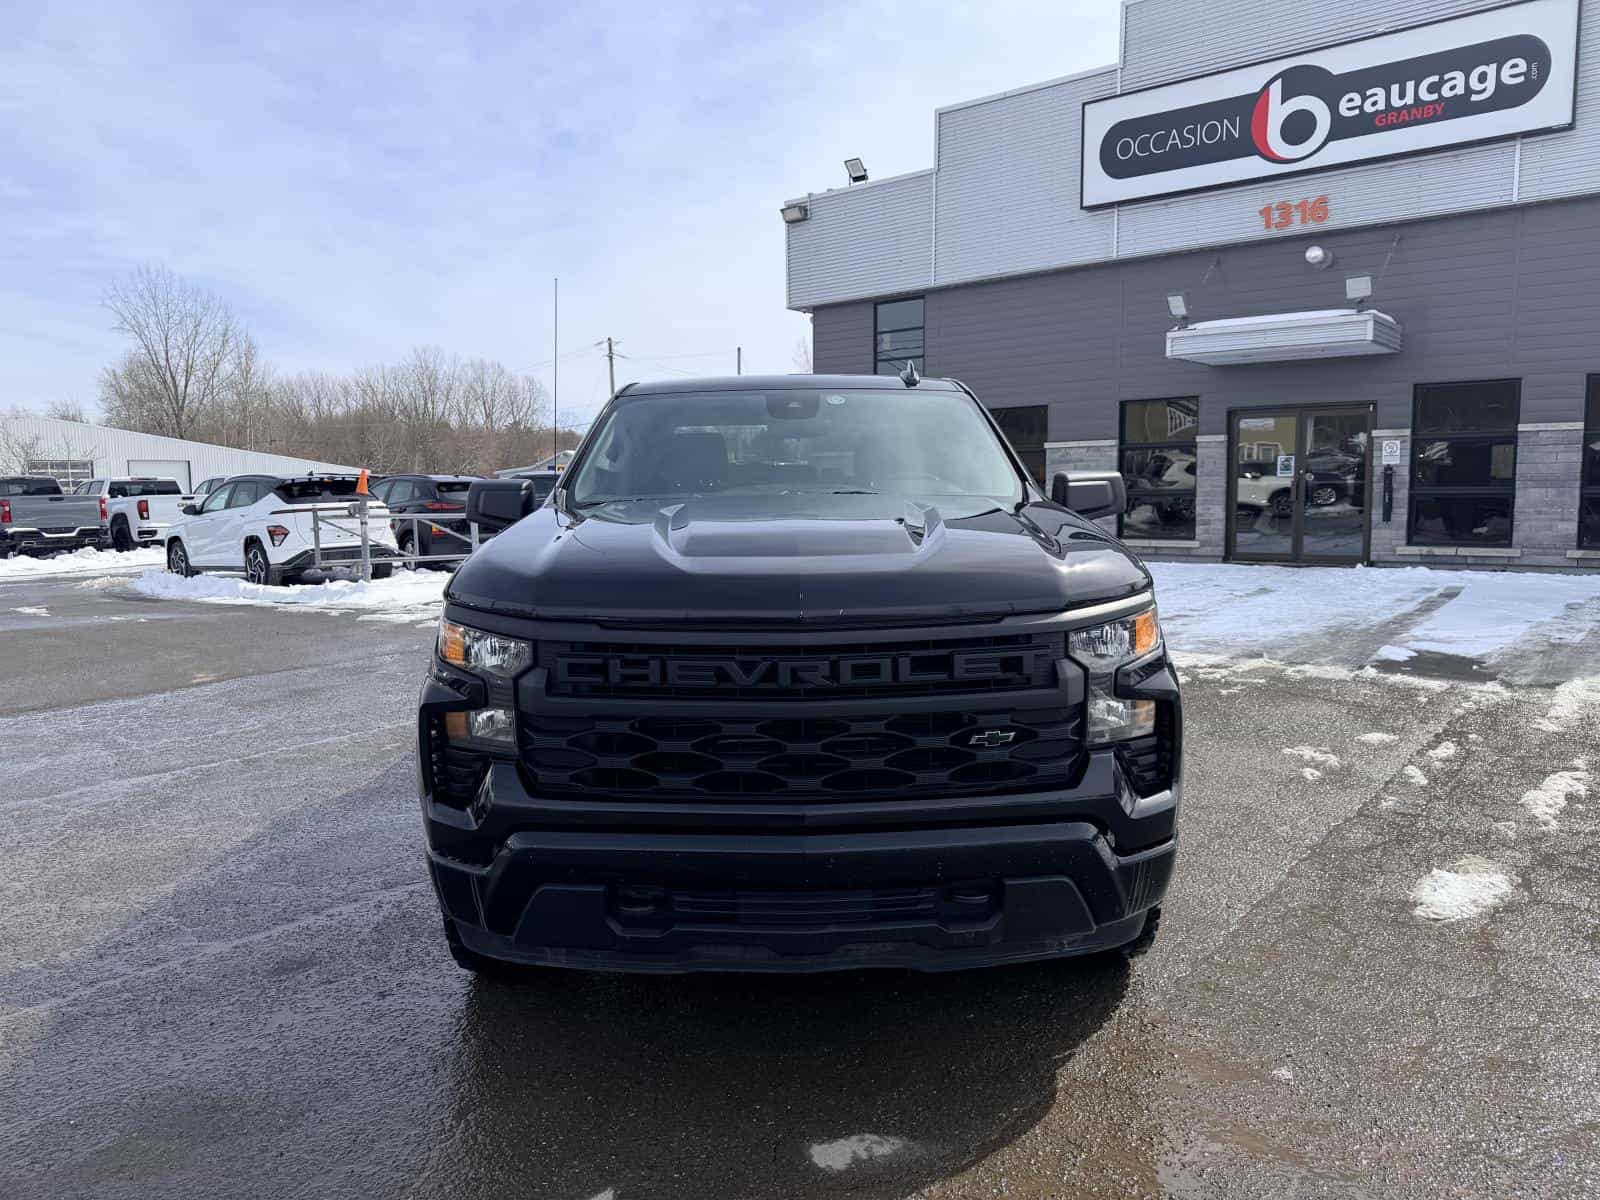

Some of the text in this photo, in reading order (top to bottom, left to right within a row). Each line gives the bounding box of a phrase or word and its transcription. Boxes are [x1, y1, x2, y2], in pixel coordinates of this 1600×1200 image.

[1375, 103, 1445, 127] GRANBY
[1116, 117, 1240, 161] OCCASION
[1258, 195, 1330, 231] 1316
[557, 650, 1043, 687] CHEVROLET
